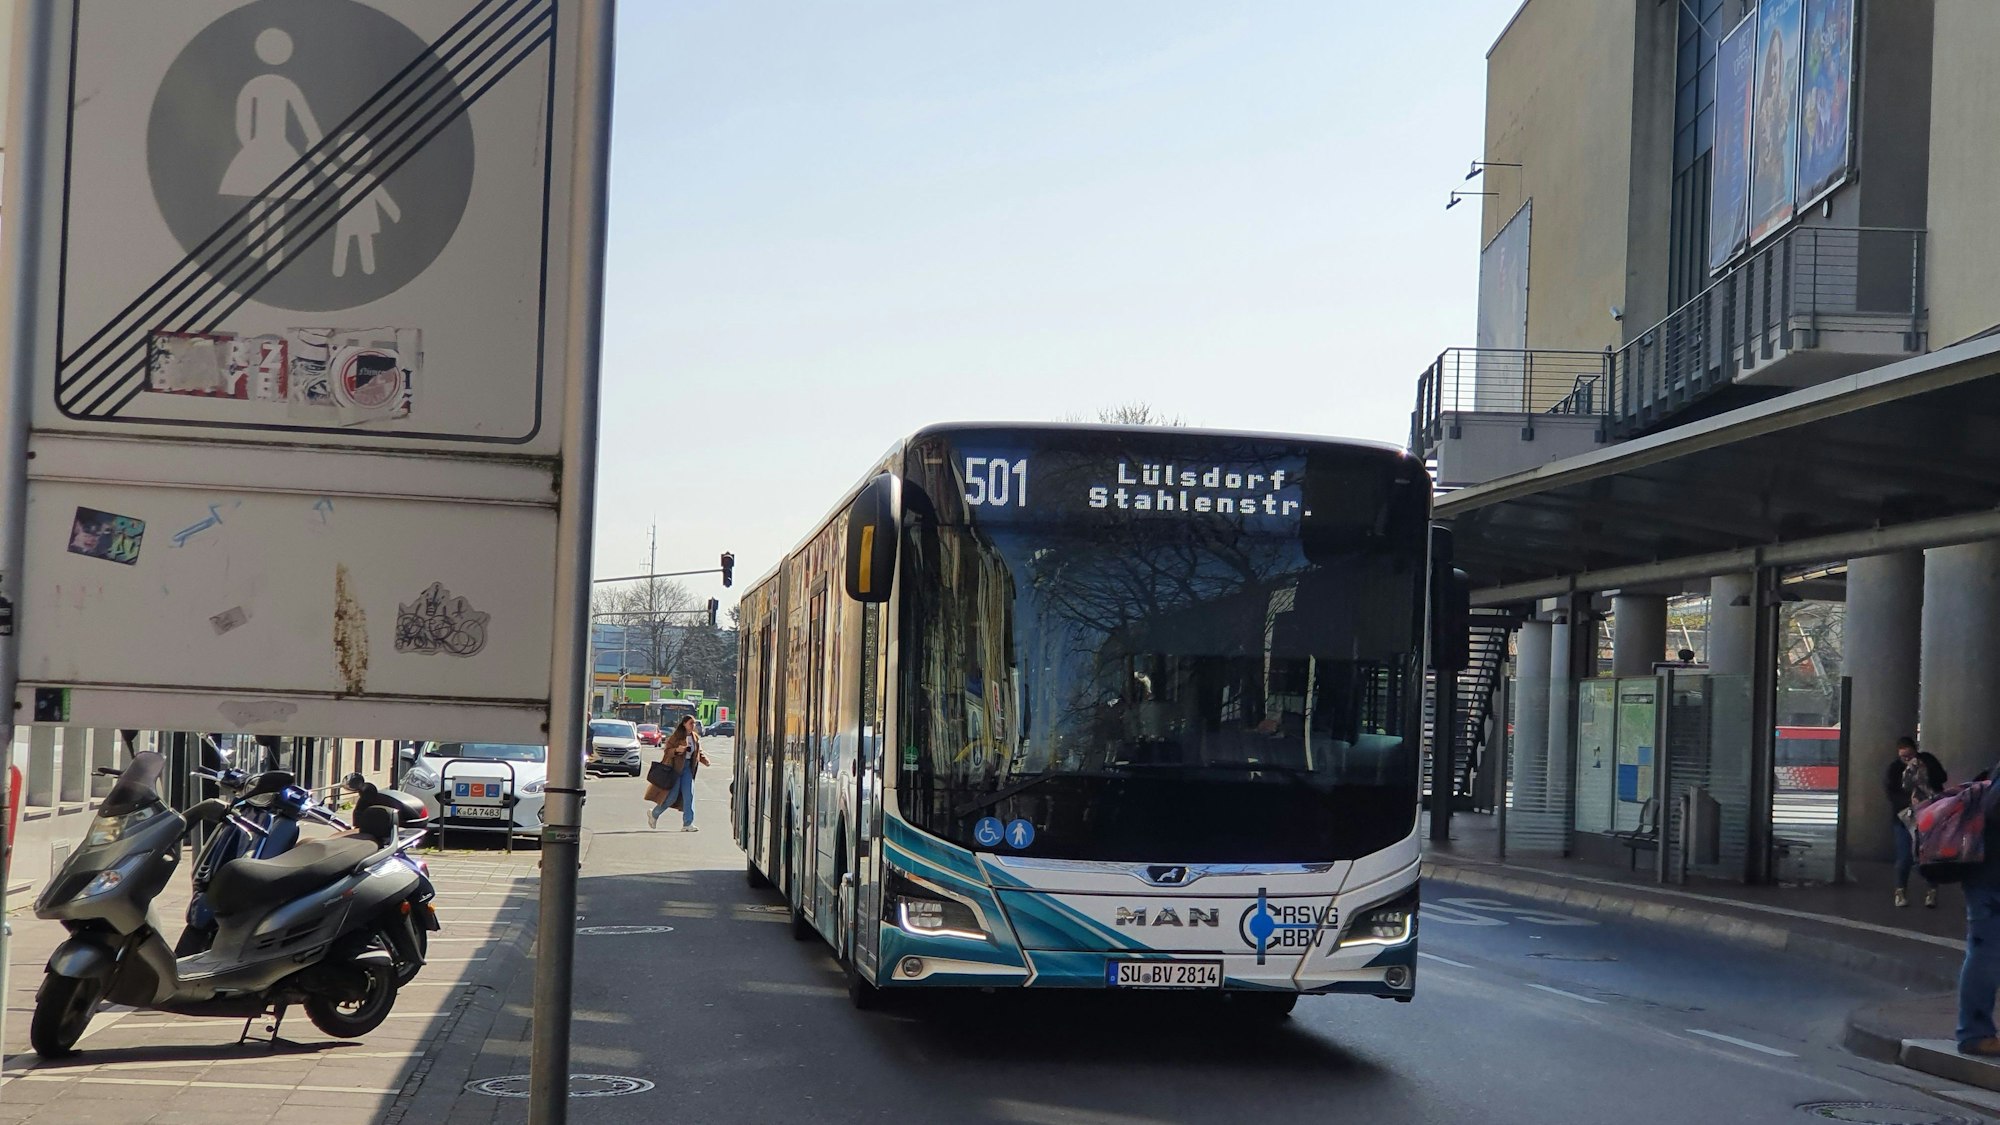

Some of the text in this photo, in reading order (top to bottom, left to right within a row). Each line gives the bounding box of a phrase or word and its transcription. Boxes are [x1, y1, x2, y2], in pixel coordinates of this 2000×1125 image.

[965, 457, 1027, 507] 501
[1118, 463, 1285, 491] Lülsdorf
[1089, 487, 1312, 516] Stahlenstr.
[467, 808, 478, 816] CA
[1116, 906, 1219, 927] MAN
[1283, 906, 1338, 924] RSVG
[1420, 898, 1600, 926] US
[1283, 929, 1324, 947] BBV
[1120, 965, 1141, 982] SU
[1152, 966, 1173, 983] BV
[1177, 966, 1216, 984] 2814
